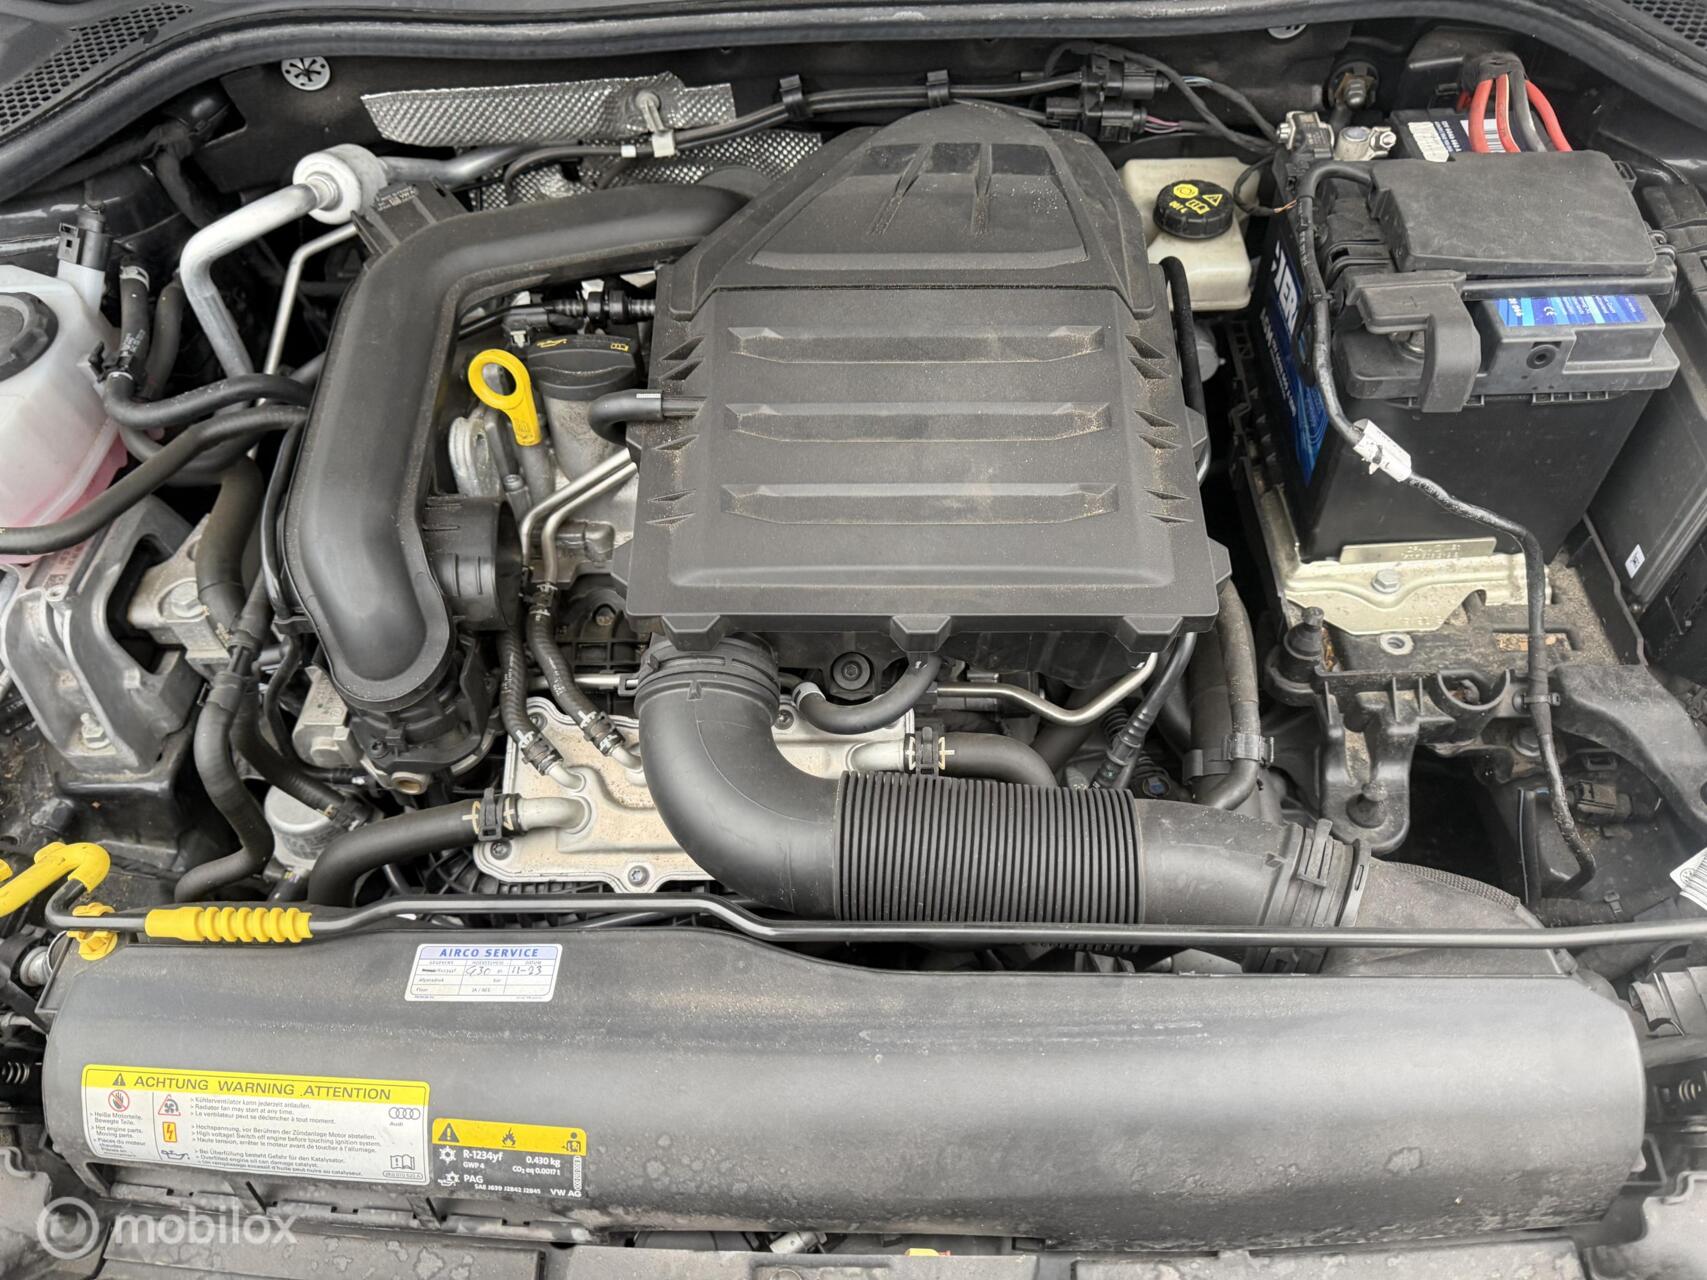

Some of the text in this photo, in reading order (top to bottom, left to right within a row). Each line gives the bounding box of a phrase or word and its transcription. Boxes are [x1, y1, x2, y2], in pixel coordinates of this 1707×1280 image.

[440, 948, 538, 958] AIRCO SERVICE
[134, 1076, 391, 1100] ACHTUNG WARNING ATTENTION
[463, 1150, 503, 1162] R-1234yf
[550, 1158, 560, 1167] kg
[463, 1175, 484, 1183] PAG
[568, 1189, 582, 1198] AG
